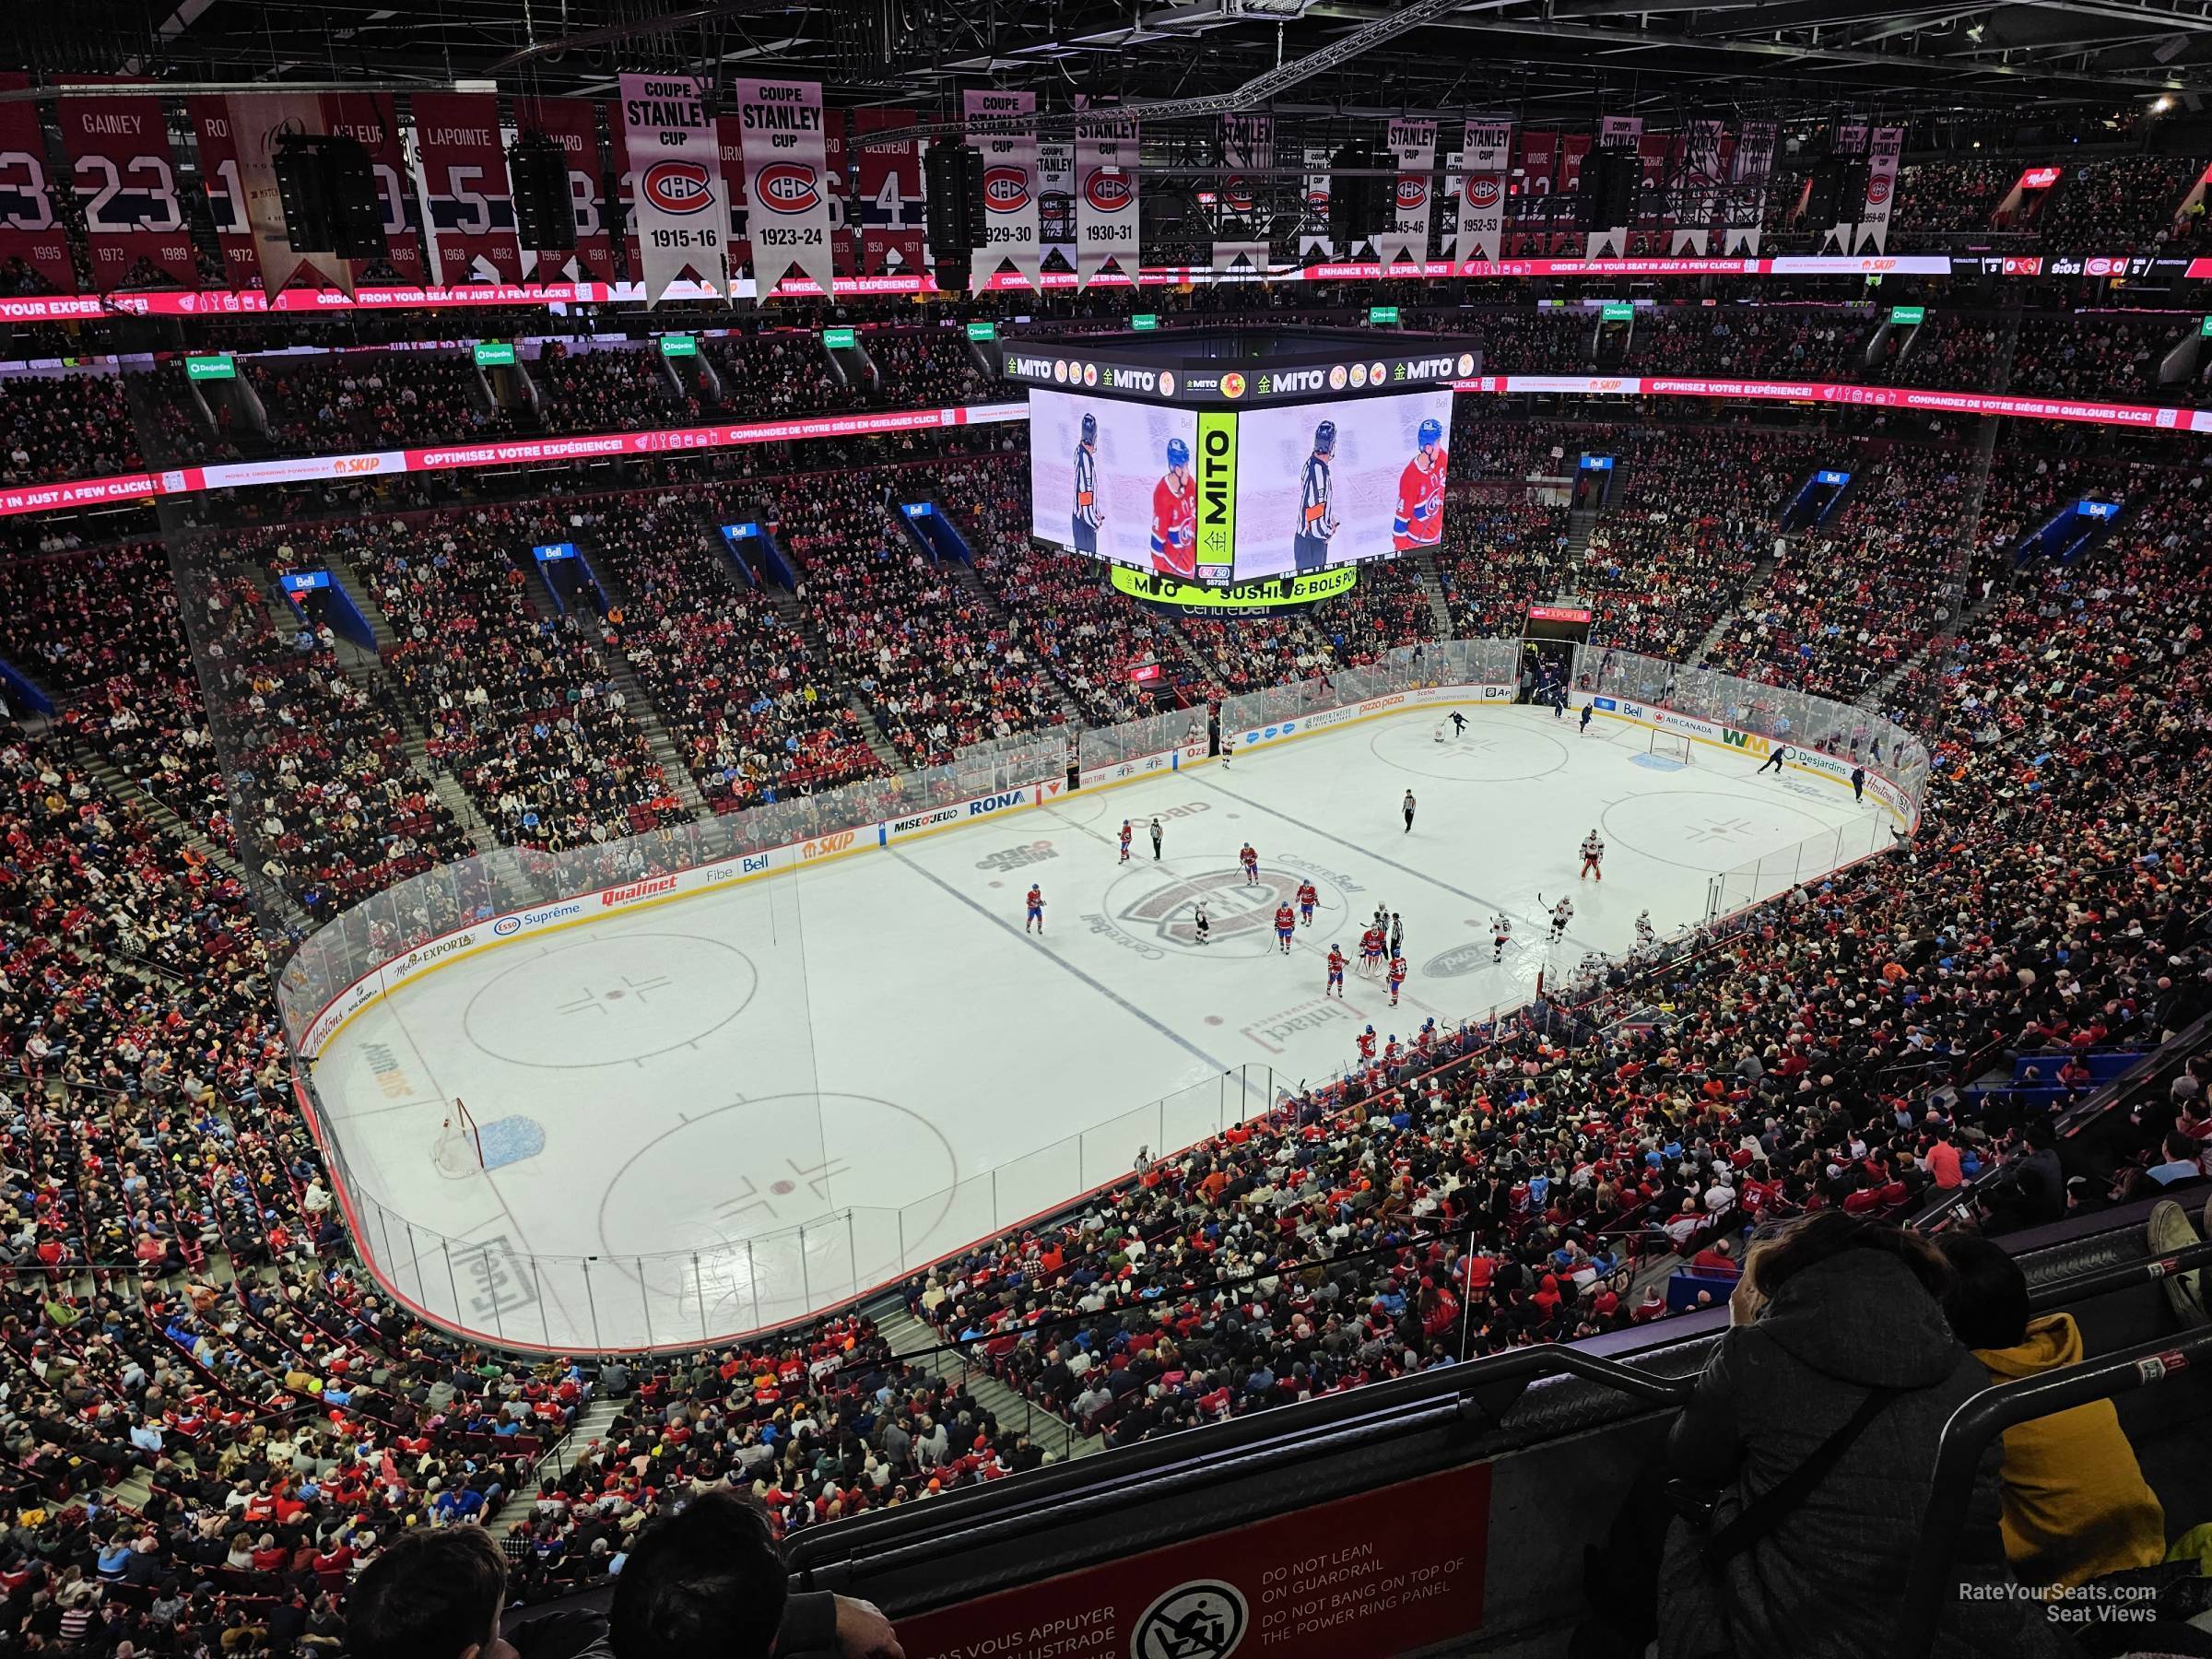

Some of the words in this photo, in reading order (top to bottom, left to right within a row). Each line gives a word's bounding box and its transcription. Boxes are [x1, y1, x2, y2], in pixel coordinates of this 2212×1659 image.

[645, 82, 690, 98] COUPE
[759, 86, 803, 102] COUPE
[982, 97, 1019, 111] COUPE
[627, 100, 712, 128] STANLEY
[743, 103, 821, 131] STANLEY
[82, 113, 141, 135] GAINEY
[1078, 120, 1137, 139] STANLEY
[1612, 121, 1631, 132] COUPE
[427, 127, 492, 147] LAPOINTE
[659, 131, 688, 146] CUP
[771, 134, 798, 148] CUP
[1390, 127, 1435, 147] STANLEY
[1466, 129, 1509, 147] STANLEY
[992, 140, 1014, 153] CUP
[1041, 147, 1064, 156] COUPE
[1099, 142, 1117, 155] CUP
[1404, 148, 1419, 160] CUP
[1871, 142, 1900, 157] STANLEY
[1478, 149, 1494, 160] CUP
[1527, 152, 1548, 165] MOORE
[1046, 173, 1060, 182] CUP
[1313, 176, 1324, 184] CUP
[74, 155, 182, 233] 23
[447, 166, 493, 236] 5
[876, 171, 908, 230] 4
[1464, 218, 1498, 232] 1952-53
[651, 229, 717, 247] 1915-16
[759, 228, 823, 246] 1923-24
[1086, 225, 1133, 241] 1930-31
[32, 246, 62, 261] 1995
[160, 246, 188, 261] 1989
[491, 247, 513, 260] 1982
[832, 241, 849, 253] 1975
[867, 241, 884, 253] 1950
[904, 241, 919, 252] 1971
[98, 247, 124, 262] 1973
[391, 247, 415, 262] 1985
[443, 247, 465, 262] 1968
[588, 249, 607, 261] 1981
[1318, 266, 1367, 276] ENHANCE
[1550, 263, 1583, 272] ORDER
[1603, 262, 1626, 271] YOUR
[1627, 262, 1647, 271] SEAT
[1648, 261, 1657, 270] IN
[1659, 261, 1679, 270] JUST
[1680, 261, 1688, 269] A
[1689, 261, 1708, 269] FEW
[1709, 261, 1741, 270] CLICKS!
[1871, 259, 1896, 270] SKIP
[2006, 260, 2016, 271] 0
[2052, 263, 2080, 275] 9:03
[2112, 261, 2124, 273] 0
[859, 278, 920, 290] EXPÉRIENCE!
[359, 292, 393, 303] FROM
[394, 291, 425, 302] YOUR
[426, 290, 453, 302] SEAT
[455, 290, 467, 300] IN
[470, 289, 495, 300] JUST
[497, 289, 506, 299] A
[508, 288, 531, 299] FEW
[534, 287, 571, 298] CLICKS!
[0, 301, 47, 317] YOUR
[670, 342, 693, 350] Desjardins
[485, 349, 512, 359] Desjardins
[199, 362, 230, 371] Desjardins
[1018, 358, 1052, 378] MITO
[1407, 359, 1453, 380] MITO
[1114, 370, 1154, 391] MITO
[1194, 380, 1218, 388] MITO
[1273, 371, 1324, 392] MITO
[1598, 379, 1621, 390] SKIP
[1653, 382, 1707, 393] OPTIMISEZ
[1708, 383, 1742, 394] VOTRE
[1744, 383, 1812, 396] EXPÉRIENCE!
[1907, 394, 1966, 406] COMMANDEZ
[1967, 398, 1981, 407] DE
[1982, 399, 2014, 411] VOTRE
[2015, 400, 2043, 413] SIÈGE
[2044, 404, 2060, 414] EN
[2061, 406, 2116, 419] QUELQUES
[2117, 411, 2152, 422] CLICS!
[730, 426, 788, 440] COMMANDEZ
[789, 425, 801, 434] DE
[802, 422, 830, 433] VOTRE
[831, 419, 856, 430] SIÈGE
[857, 418, 868, 429] EN
[869, 416, 912, 429] QUELQUES
[913, 414, 938, 424] CLICS!
[423, 449, 495, 465] OPTIMISEZ
[498, 446, 541, 460] VOTRE
[543, 438, 623, 456] EXPÉRIENCE!
[348, 457, 380, 472] SKIP
[1590, 458, 1604, 467] Bell
[1205, 429, 1230, 524] MITO
[1826, 473, 1840, 483] Bell
[6, 497, 23, 508] IN
[26, 492, 59, 506] JUST
[63, 490, 74, 501] A
[76, 487, 105, 500] FEW
[108, 480, 159, 496] CLICKS!
[909, 505, 924, 515] Bell
[2089, 503, 2107, 515] Bell
[731, 525, 747, 536] Bell
[546, 547, 561, 559] Bell
[1201, 567, 1228, 577] 50/50
[295, 575, 315, 588] Bell
[1206, 579, 1230, 587] 55720$
[1294, 583, 1306, 595] &
[1309, 577, 1341, 594] BOLS
[1359, 700, 1382, 715] pizza
[1382, 695, 1405, 709] pizza
[1623, 703, 1642, 719] Bell
[1665, 716, 1678, 725] AIR
[1679, 719, 1712, 735] CANADA
[1723, 728, 1770, 755] WM
[1799, 751, 1847, 775] Desjardins
[1866, 776, 1895, 804] Hortons
[970, 791, 1026, 816] RONA
[818, 831, 855, 857] SKIP
[706, 867, 734, 882] Fibe
[743, 854, 769, 873] Bell
[602, 876, 678, 907] Qualinet
[498, 920, 517, 932] Esso
[524, 903, 582, 926] Suprême
[1080, 913, 1166, 960] CentreBell
[394, 957, 424, 977] Molson
[424, 938, 465, 961] EXPORT
[1261, 1004, 1343, 1041] intact
[312, 1010, 343, 1051] Hortons
[1263, 1568, 1288, 1585] DO
[1292, 1555, 1327, 1576] NOT
[1332, 1542, 1373, 1565] LEAN
[1262, 1585, 1288, 1604] ON
[1292, 1559, 1384, 1594] GUARDRAIL
[1262, 1610, 1287, 1628] DO
[1292, 1598, 1326, 1619] NOT
[1331, 1583, 1376, 1608] BANG
[1381, 1574, 1405, 1593] ON
[1409, 1565, 1440, 1583] TOP
[1444, 1557, 1465, 1573] OF
[1261, 1626, 1291, 1646] THE
[1297, 1608, 1355, 1636] POWER
[1359, 1595, 1396, 1618] RING
[1402, 1580, 1452, 1605] PANEL
[966, 1631, 1023, 1659] VOUS
[1028, 1606, 1116, 1642] APPUYER
